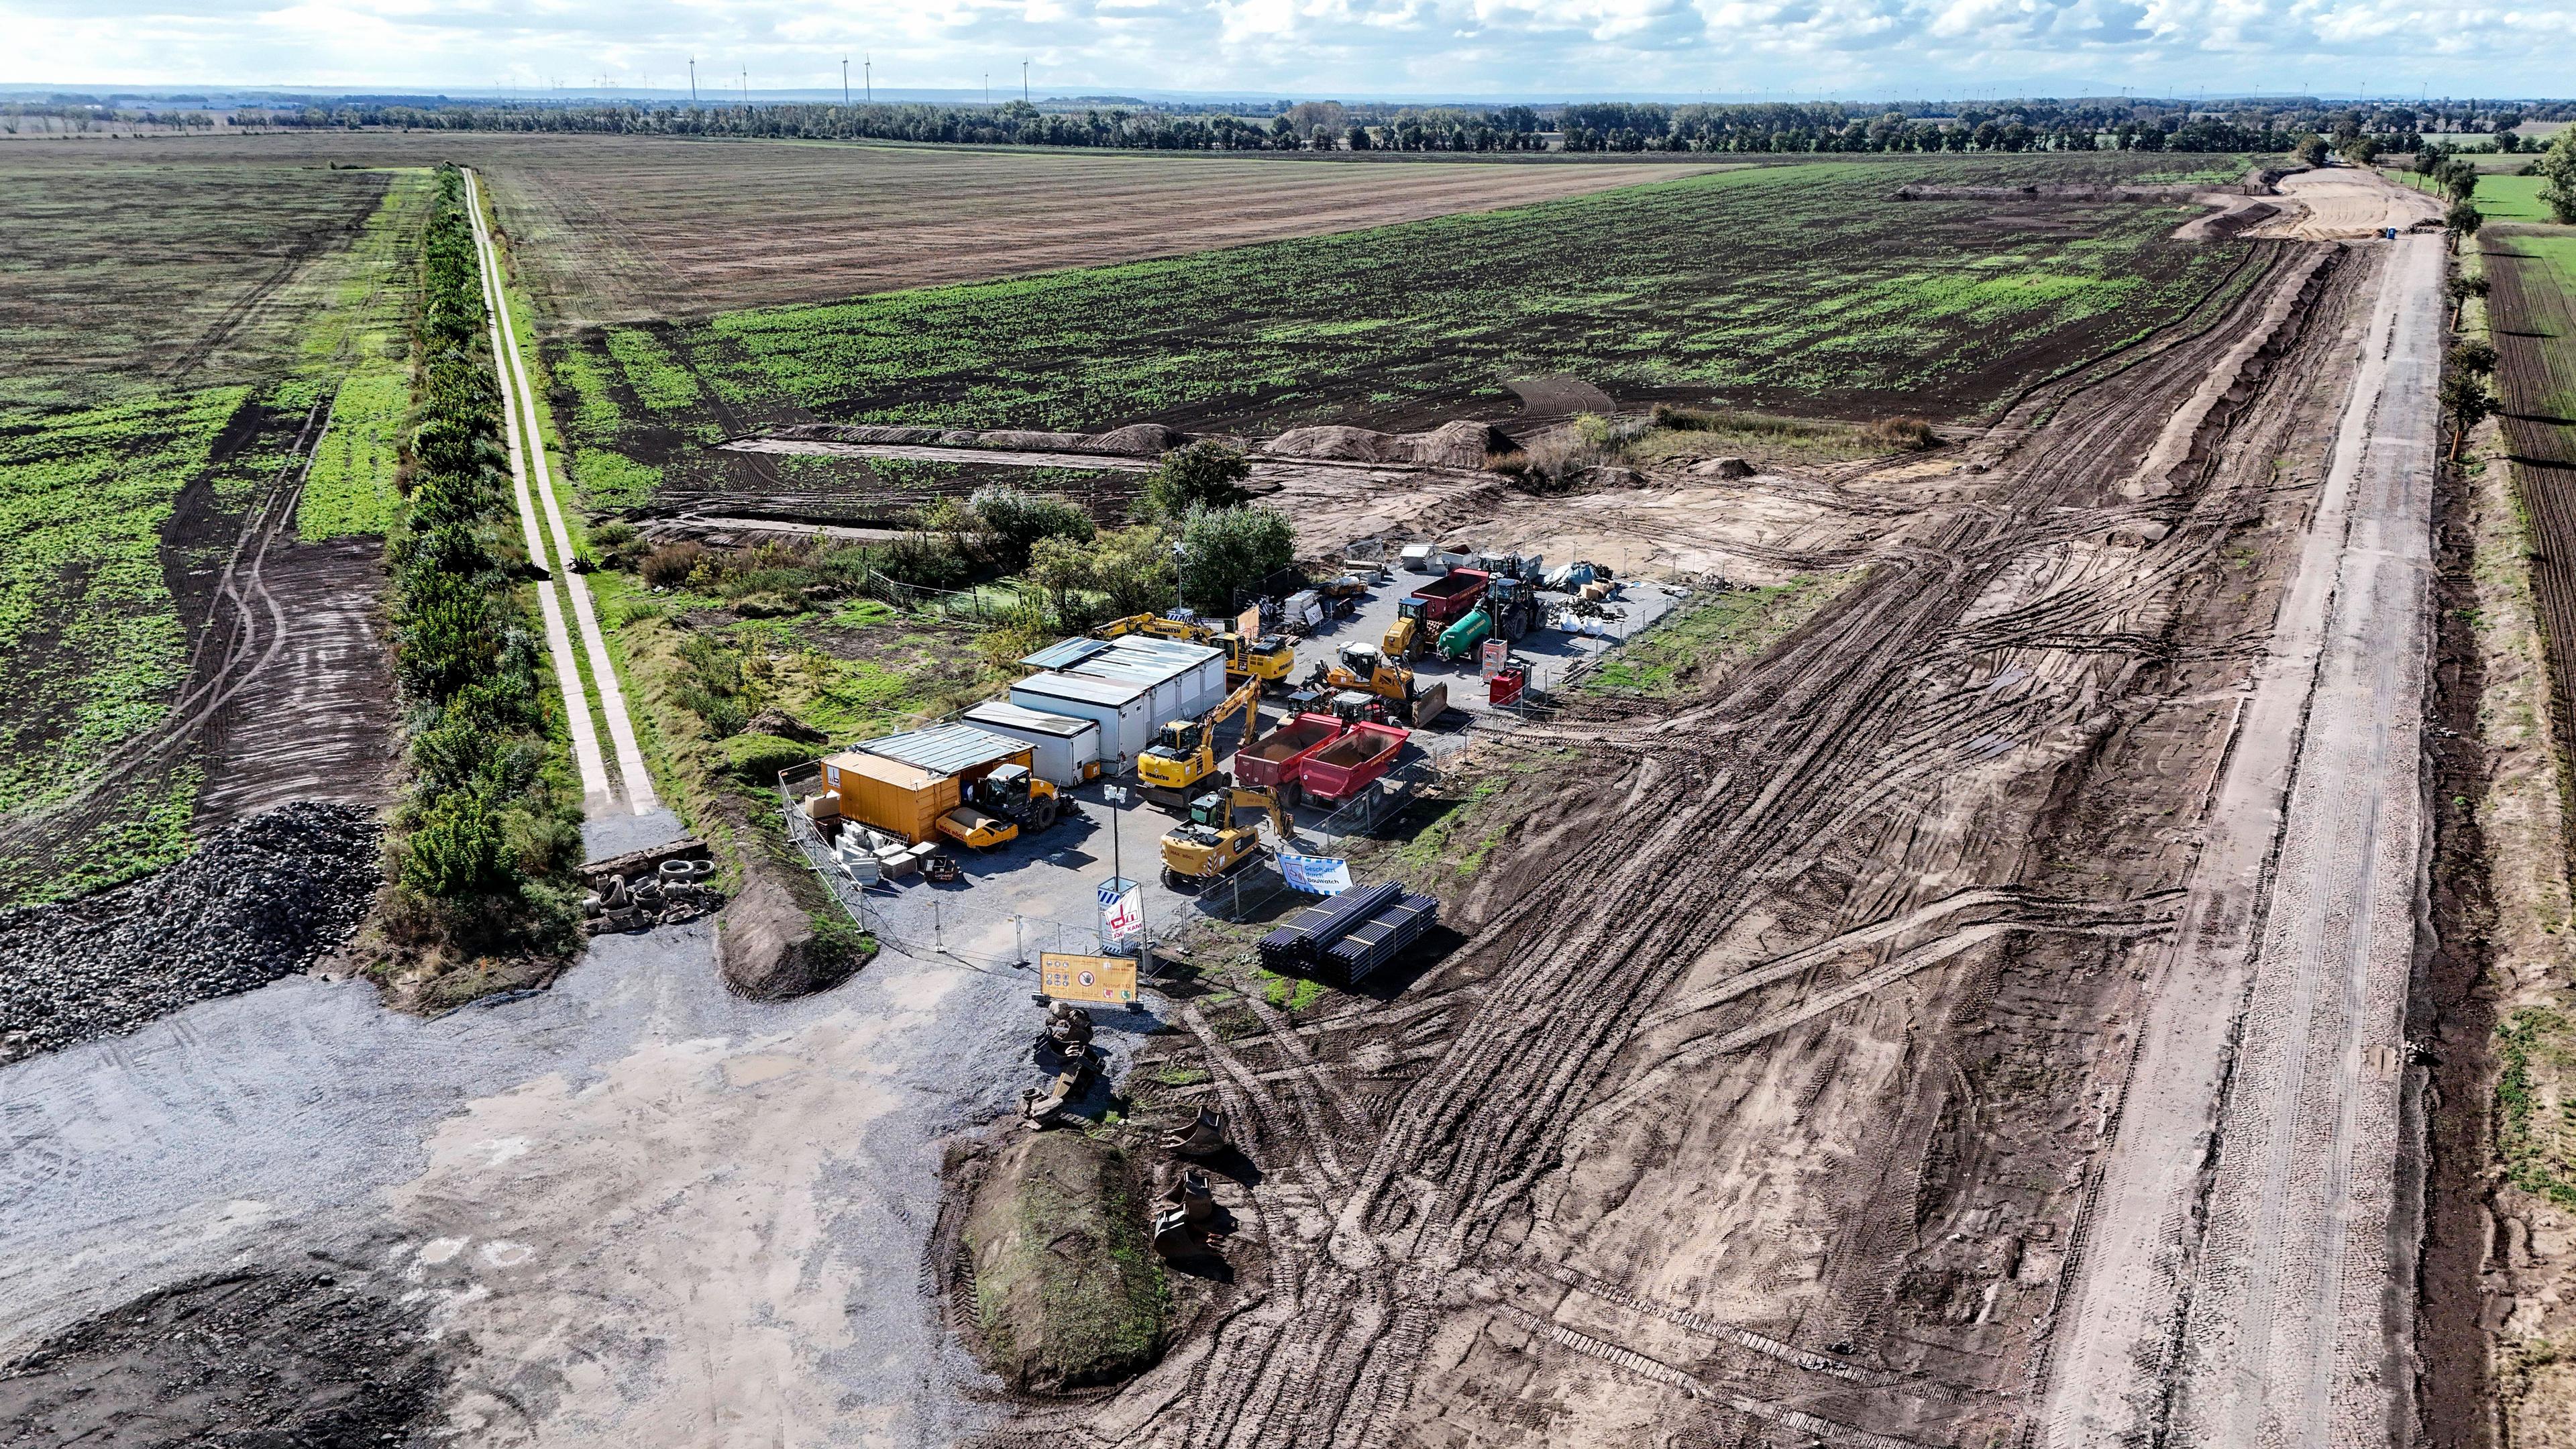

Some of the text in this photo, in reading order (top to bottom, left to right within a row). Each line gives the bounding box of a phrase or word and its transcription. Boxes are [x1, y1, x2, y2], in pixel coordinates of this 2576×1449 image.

[1279, 658, 1295, 672] KOMATSU
[1226, 700, 1242, 715] KOMATSU
[1145, 771, 1169, 781] KOMATSU
[939, 824, 965, 841] MAX BÖGL
